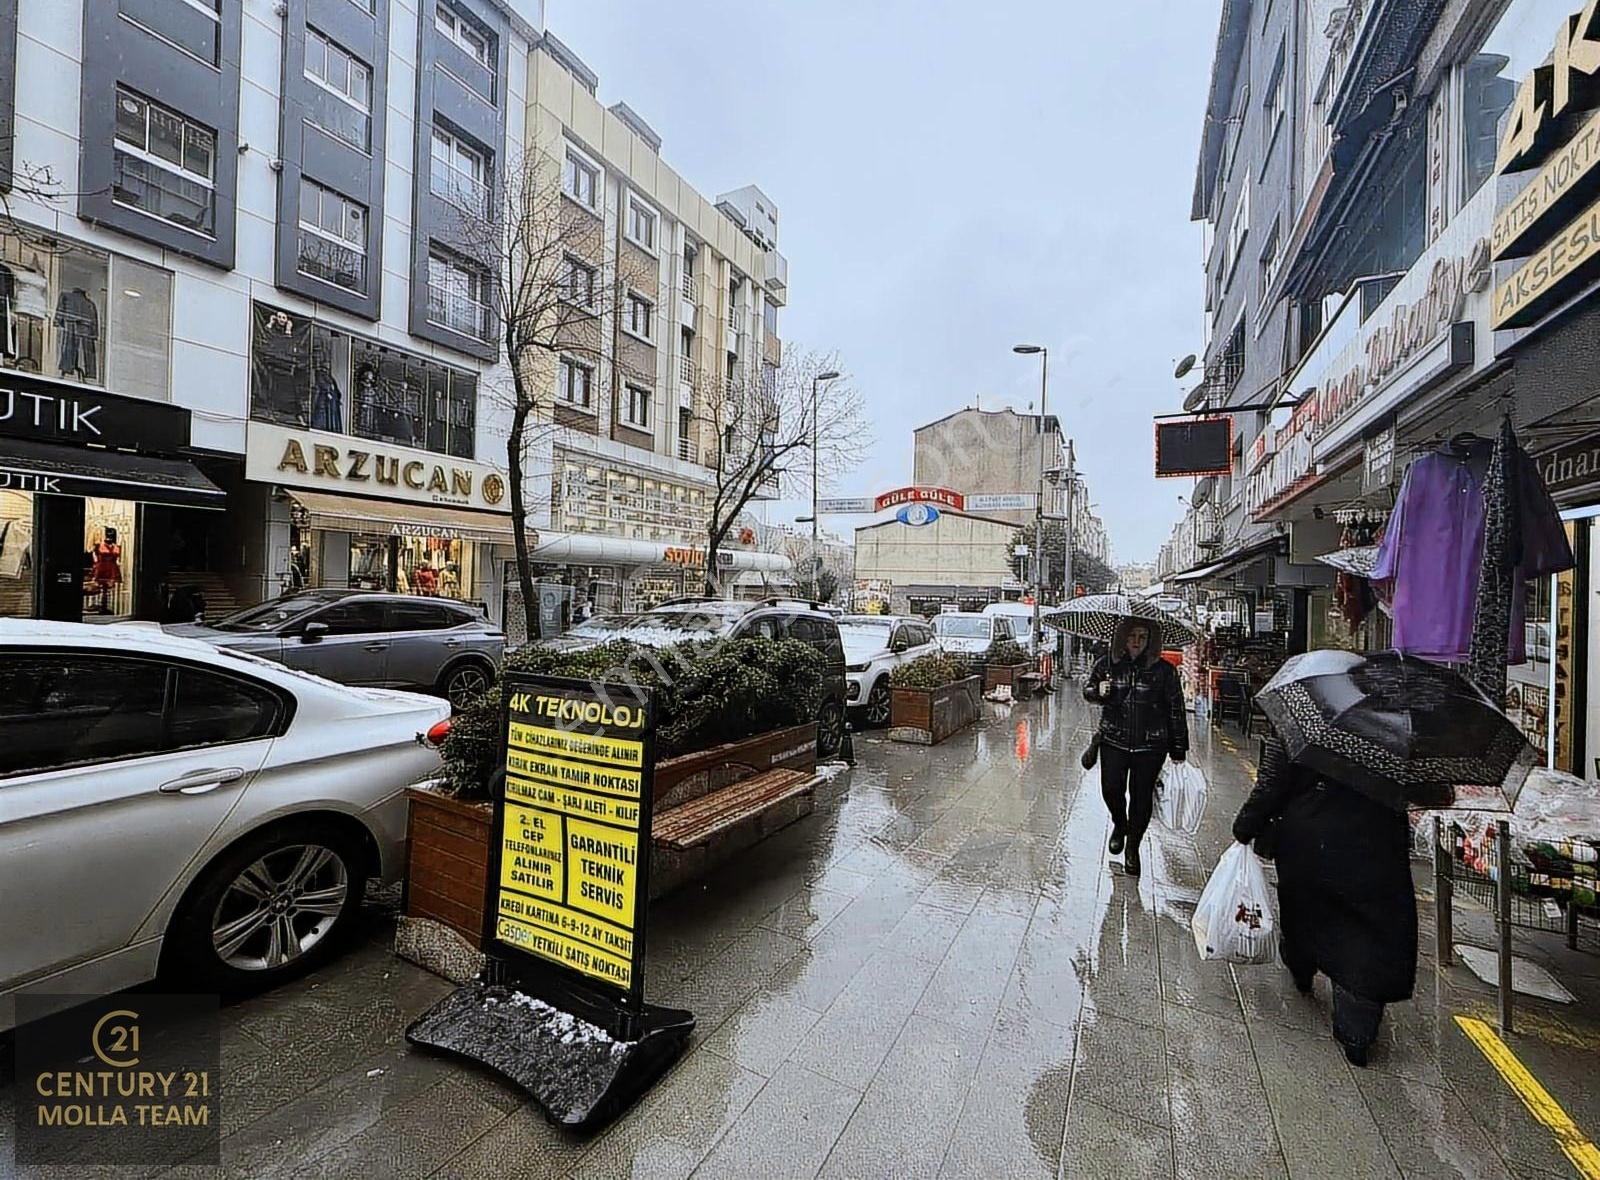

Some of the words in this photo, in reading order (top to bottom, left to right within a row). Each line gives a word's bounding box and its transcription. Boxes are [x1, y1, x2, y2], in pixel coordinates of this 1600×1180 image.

[1492, 188, 1538, 250] SATIŞ
[277, 438, 474, 497] ARZUCAN
[882, 490, 915, 507] GÜLE
[920, 489, 955, 505] GÜLE
[391, 524, 458, 538] ARZUCAN
[509, 692, 531, 713] 4K
[611, 747, 639, 763] ALINIR
[530, 761, 558, 779] EKRAN
[561, 766, 590, 784] TAMİR
[593, 773, 639, 793] NOKTASI
[519, 814, 530, 826] 2.
[533, 816, 546, 830] EL
[584, 797, 606, 815] ALETİ
[615, 808, 639, 822] KILIF
[523, 829, 544, 842] CEP
[570, 833, 636, 866] GARANTİLİ
[514, 857, 552, 876] ALINIR
[580, 858, 625, 887] TEKNİK
[511, 870, 554, 891] SATILIR
[580, 880, 624, 910] SERVİS
[500, 896, 524, 915] KREDİ
[525, 902, 559, 926] KARTINA
[561, 916, 590, 938] 6-9-12
[592, 926, 604, 940] AY
[604, 931, 632, 955] TAKSİT
[532, 935, 563, 957] YETKİLİ
[566, 946, 590, 970] SATIŞ
[592, 955, 630, 983] NOKTASI
